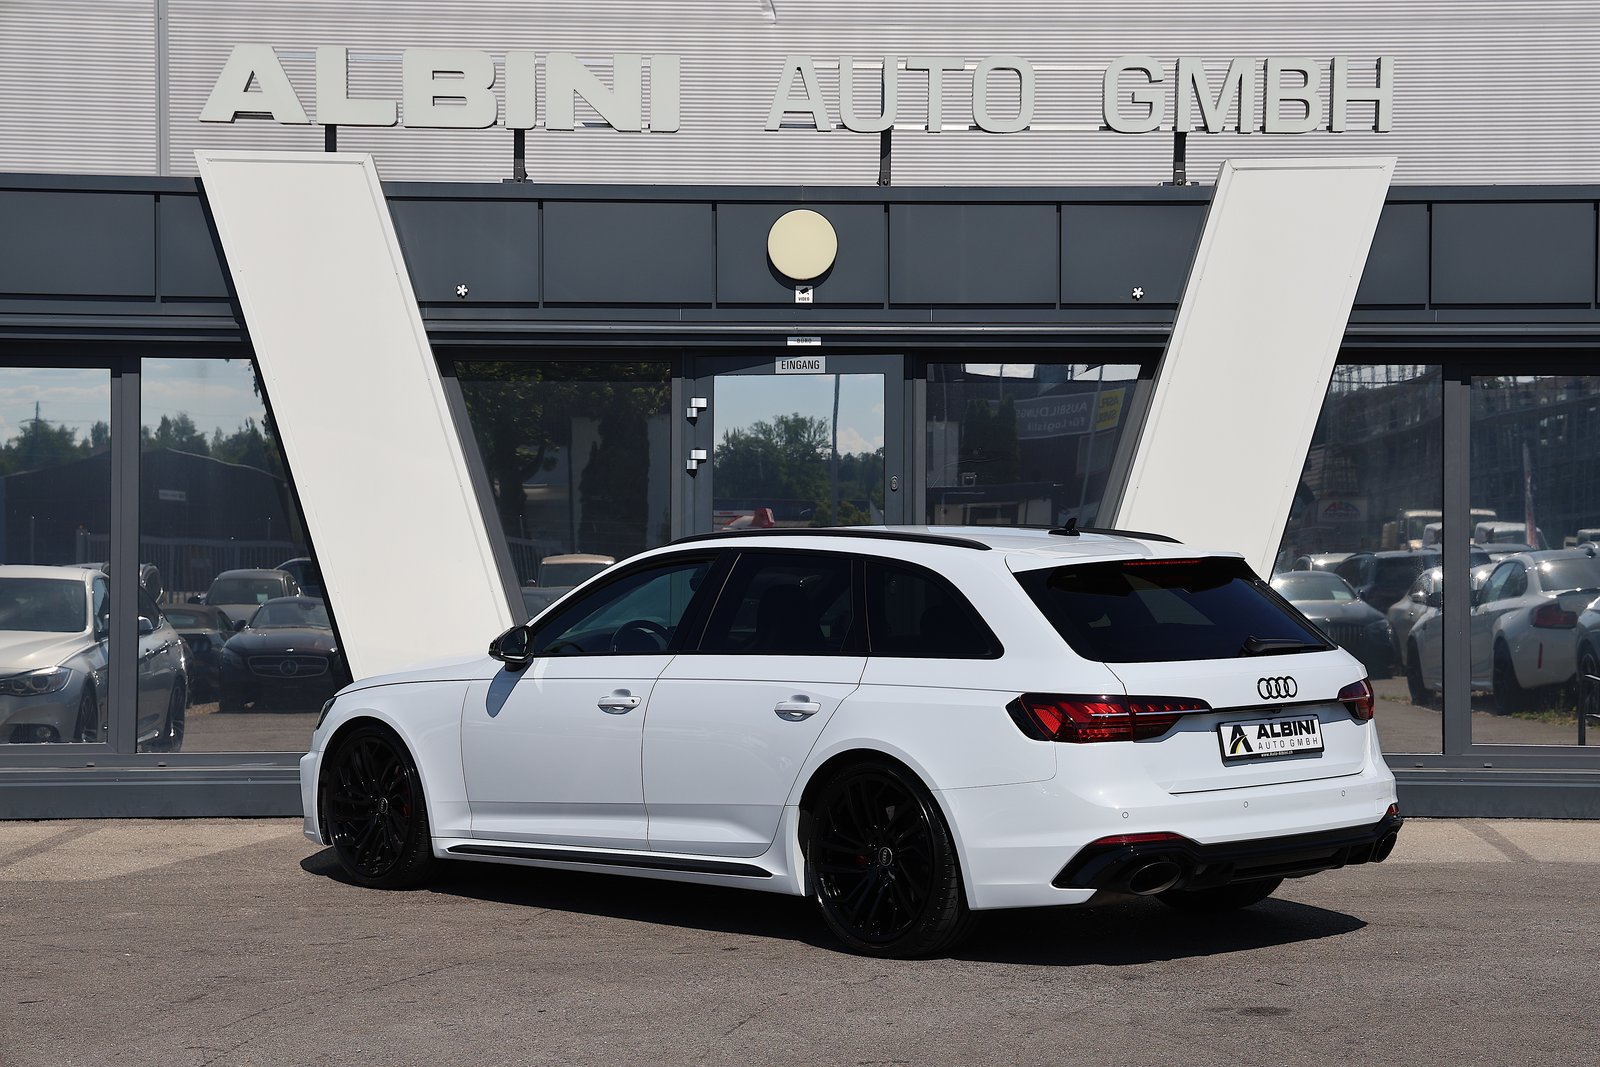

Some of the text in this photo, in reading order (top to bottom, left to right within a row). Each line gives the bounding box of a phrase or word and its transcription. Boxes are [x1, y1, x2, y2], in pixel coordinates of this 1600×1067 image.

[198, 43, 1395, 134] ALBINI AUTO GMBH
[781, 360, 820, 370] EINGANG
[1257, 720, 1316, 739] ALBINI
[1258, 737, 1318, 750] AUTO GMBH
